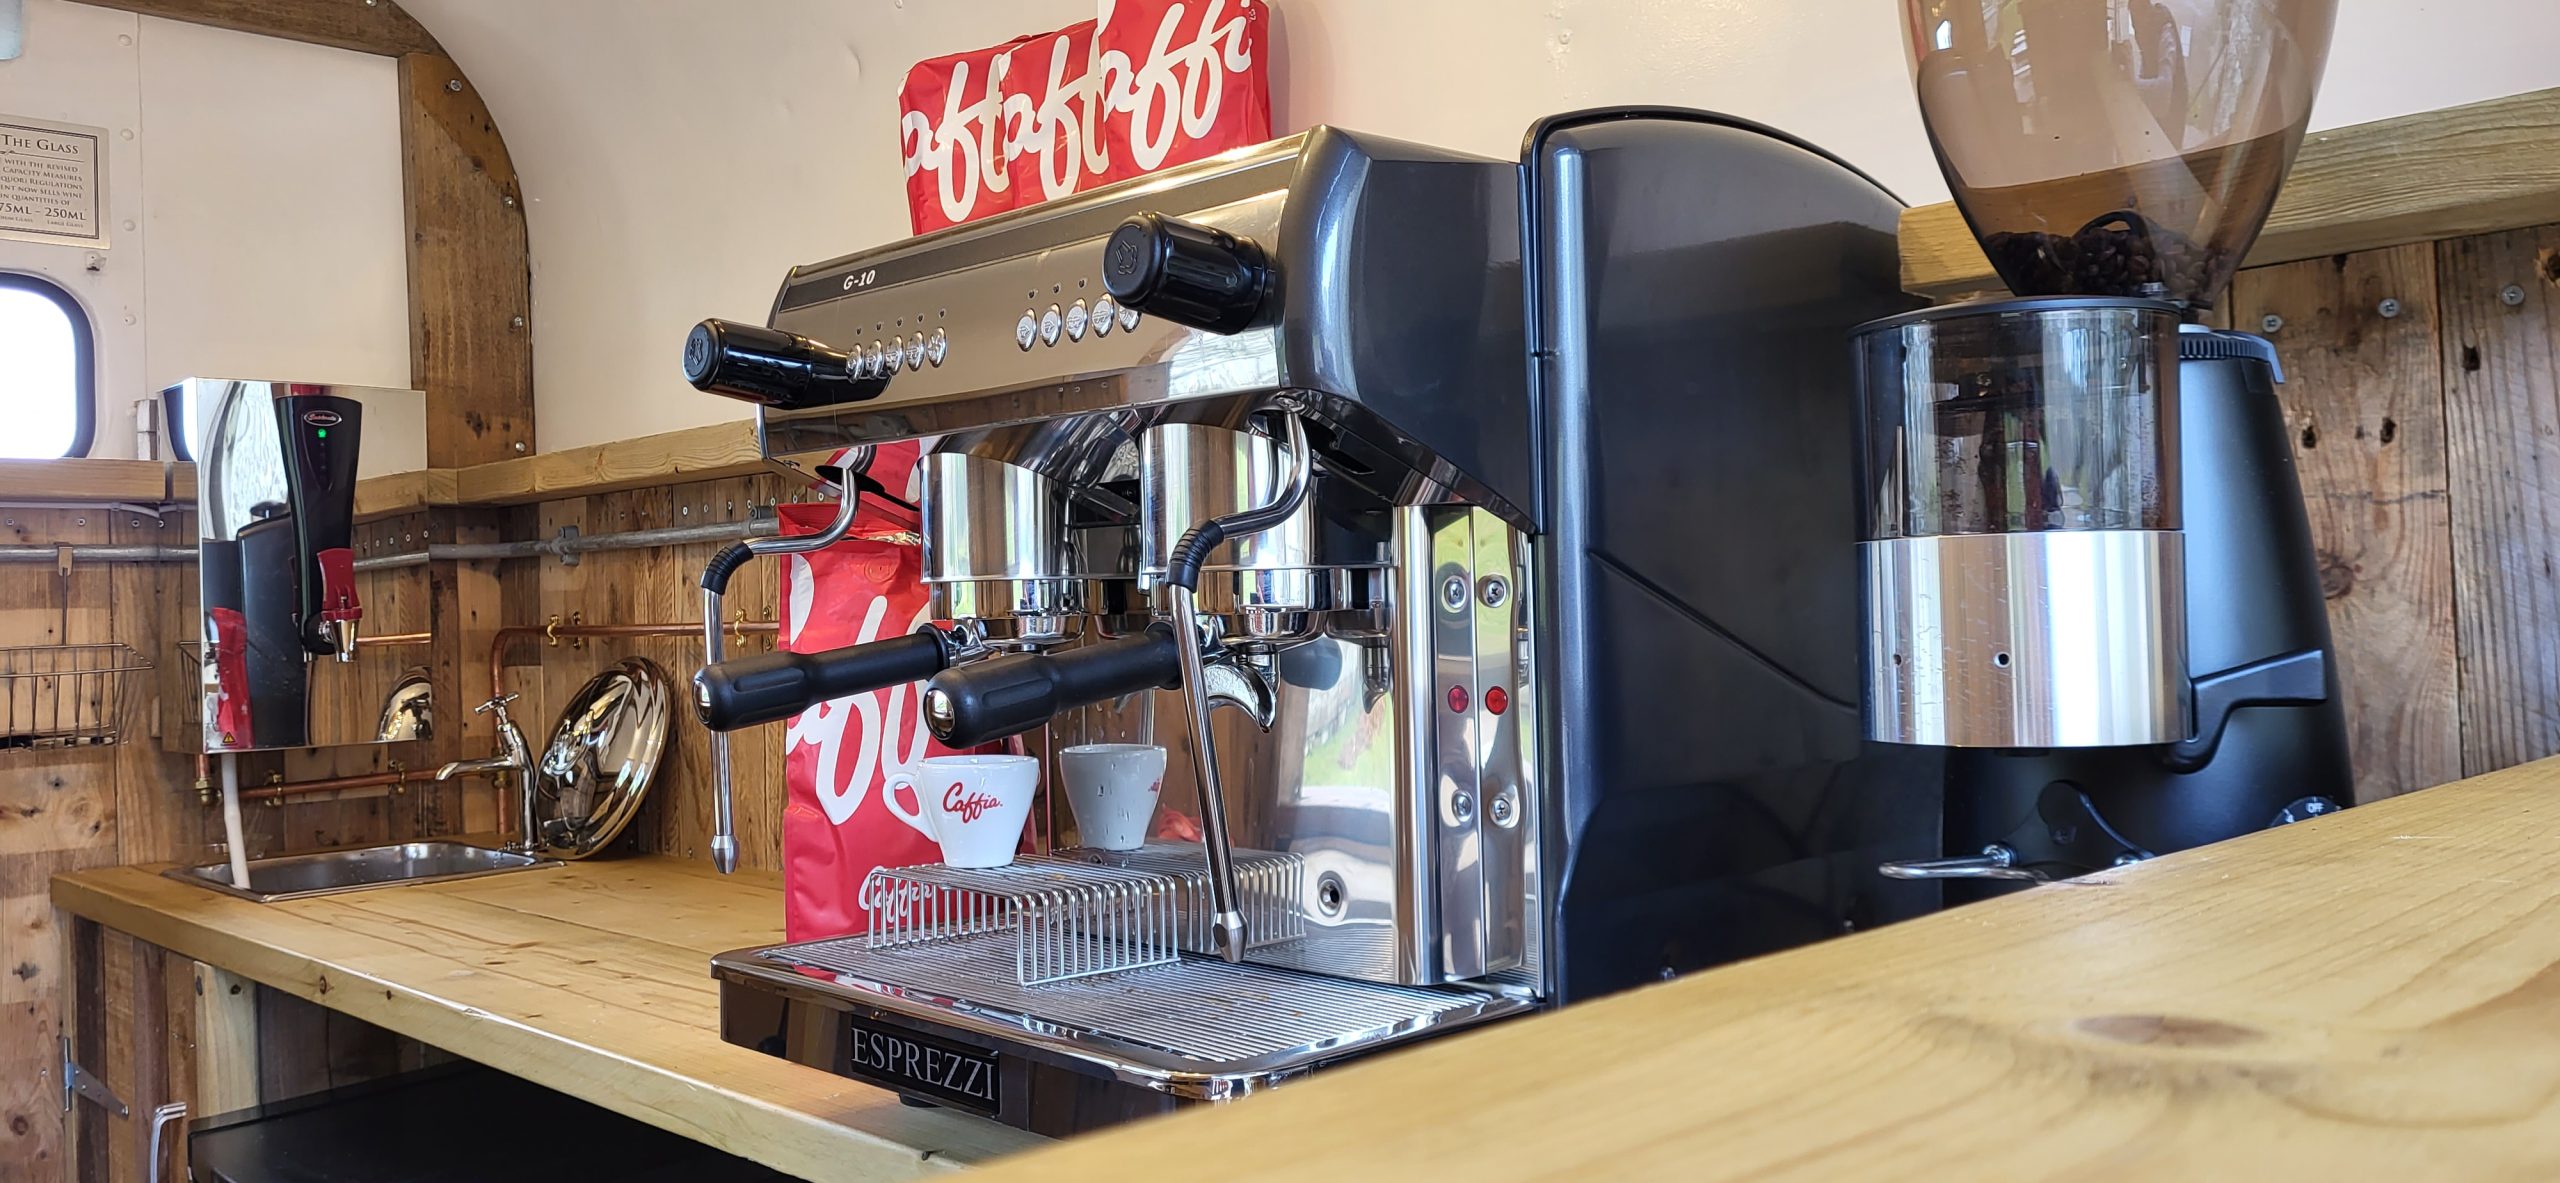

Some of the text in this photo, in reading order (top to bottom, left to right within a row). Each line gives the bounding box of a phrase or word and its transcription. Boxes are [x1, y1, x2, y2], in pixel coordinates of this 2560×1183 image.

[1, 133, 79, 155] THE GLASS
[4, 158, 79, 173] WITH THE REVISED
[2, 166, 83, 181] CAPACITY MEASURES
[12, 193, 59, 206] QUANTITIES
[18, 186, 38, 194] NOW
[62, 191, 82, 199] WINE
[44, 206, 87, 221] 250ML
[843, 269, 876, 290] G-10
[851, 1027, 996, 1101] ESPREZZI
